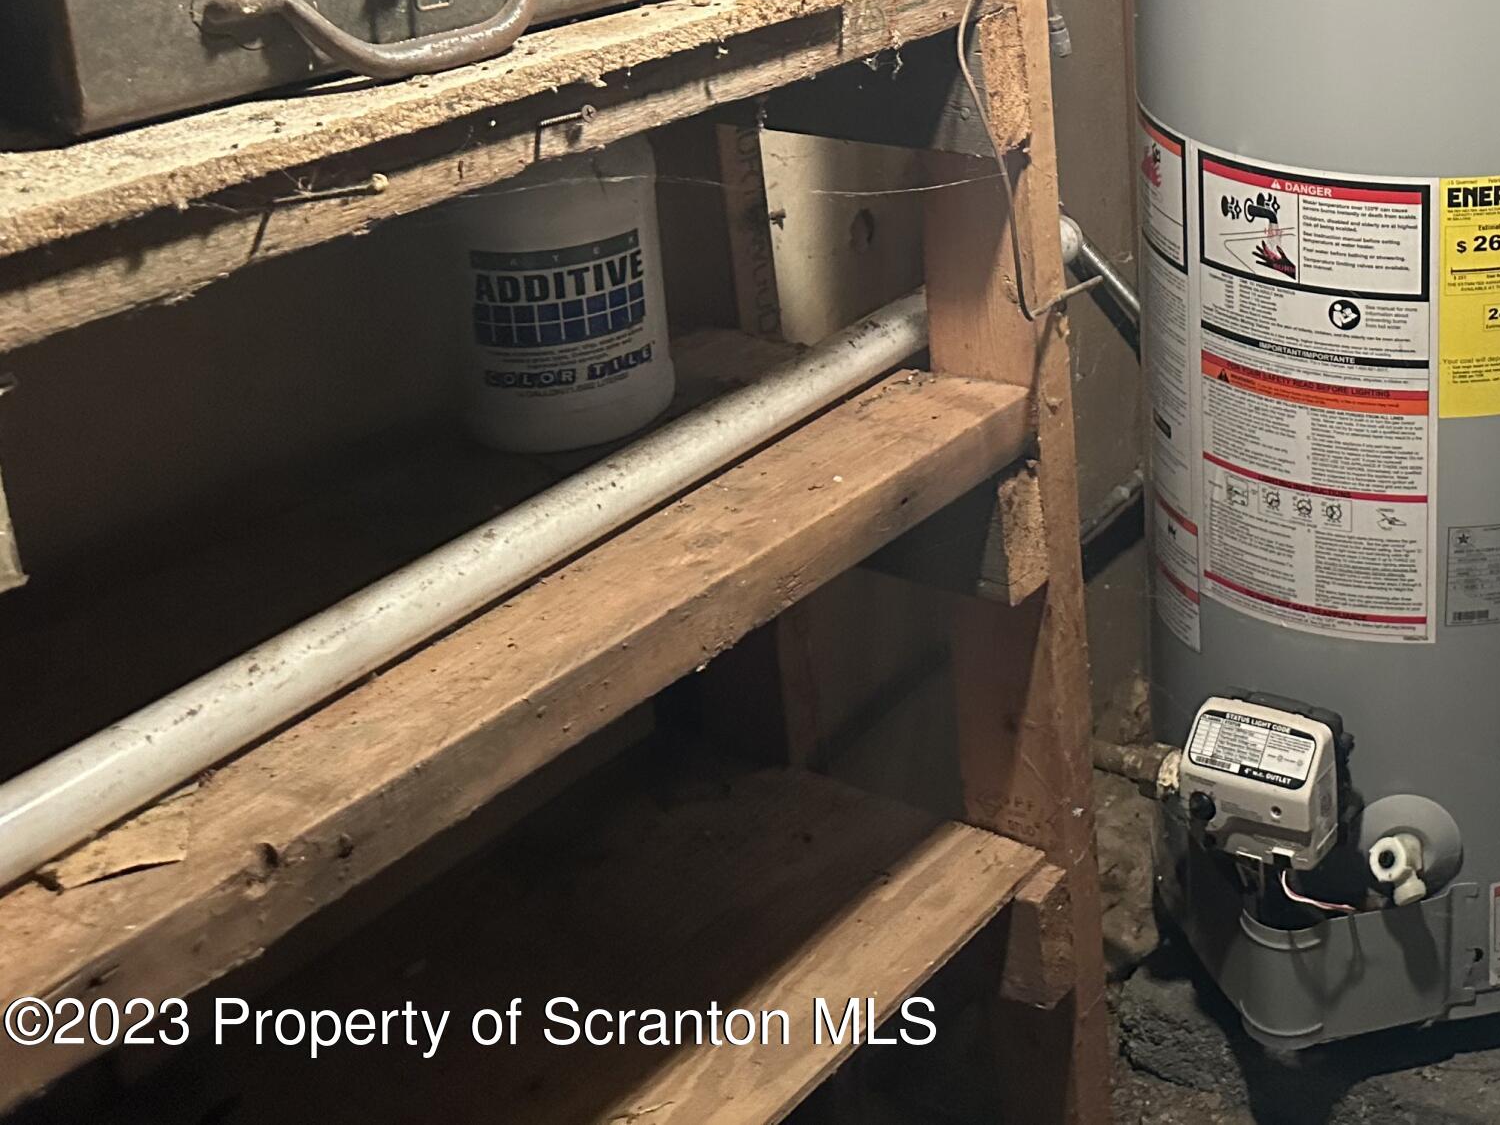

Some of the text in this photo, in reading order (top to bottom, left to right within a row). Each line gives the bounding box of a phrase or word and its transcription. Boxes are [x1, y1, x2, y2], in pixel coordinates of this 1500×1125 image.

[1284, 181, 1333, 198] DANGER
[1456, 240, 1467, 254] $
[475, 249, 644, 304] ADDITIVE
[594, 346, 651, 377] TILE
[1258, 341, 1356, 365] IMPORTANT/IMPORTANTE
[1225, 712, 1291, 734] STATUS LIGHT CODE
[1265, 773, 1292, 785] OUTLET
